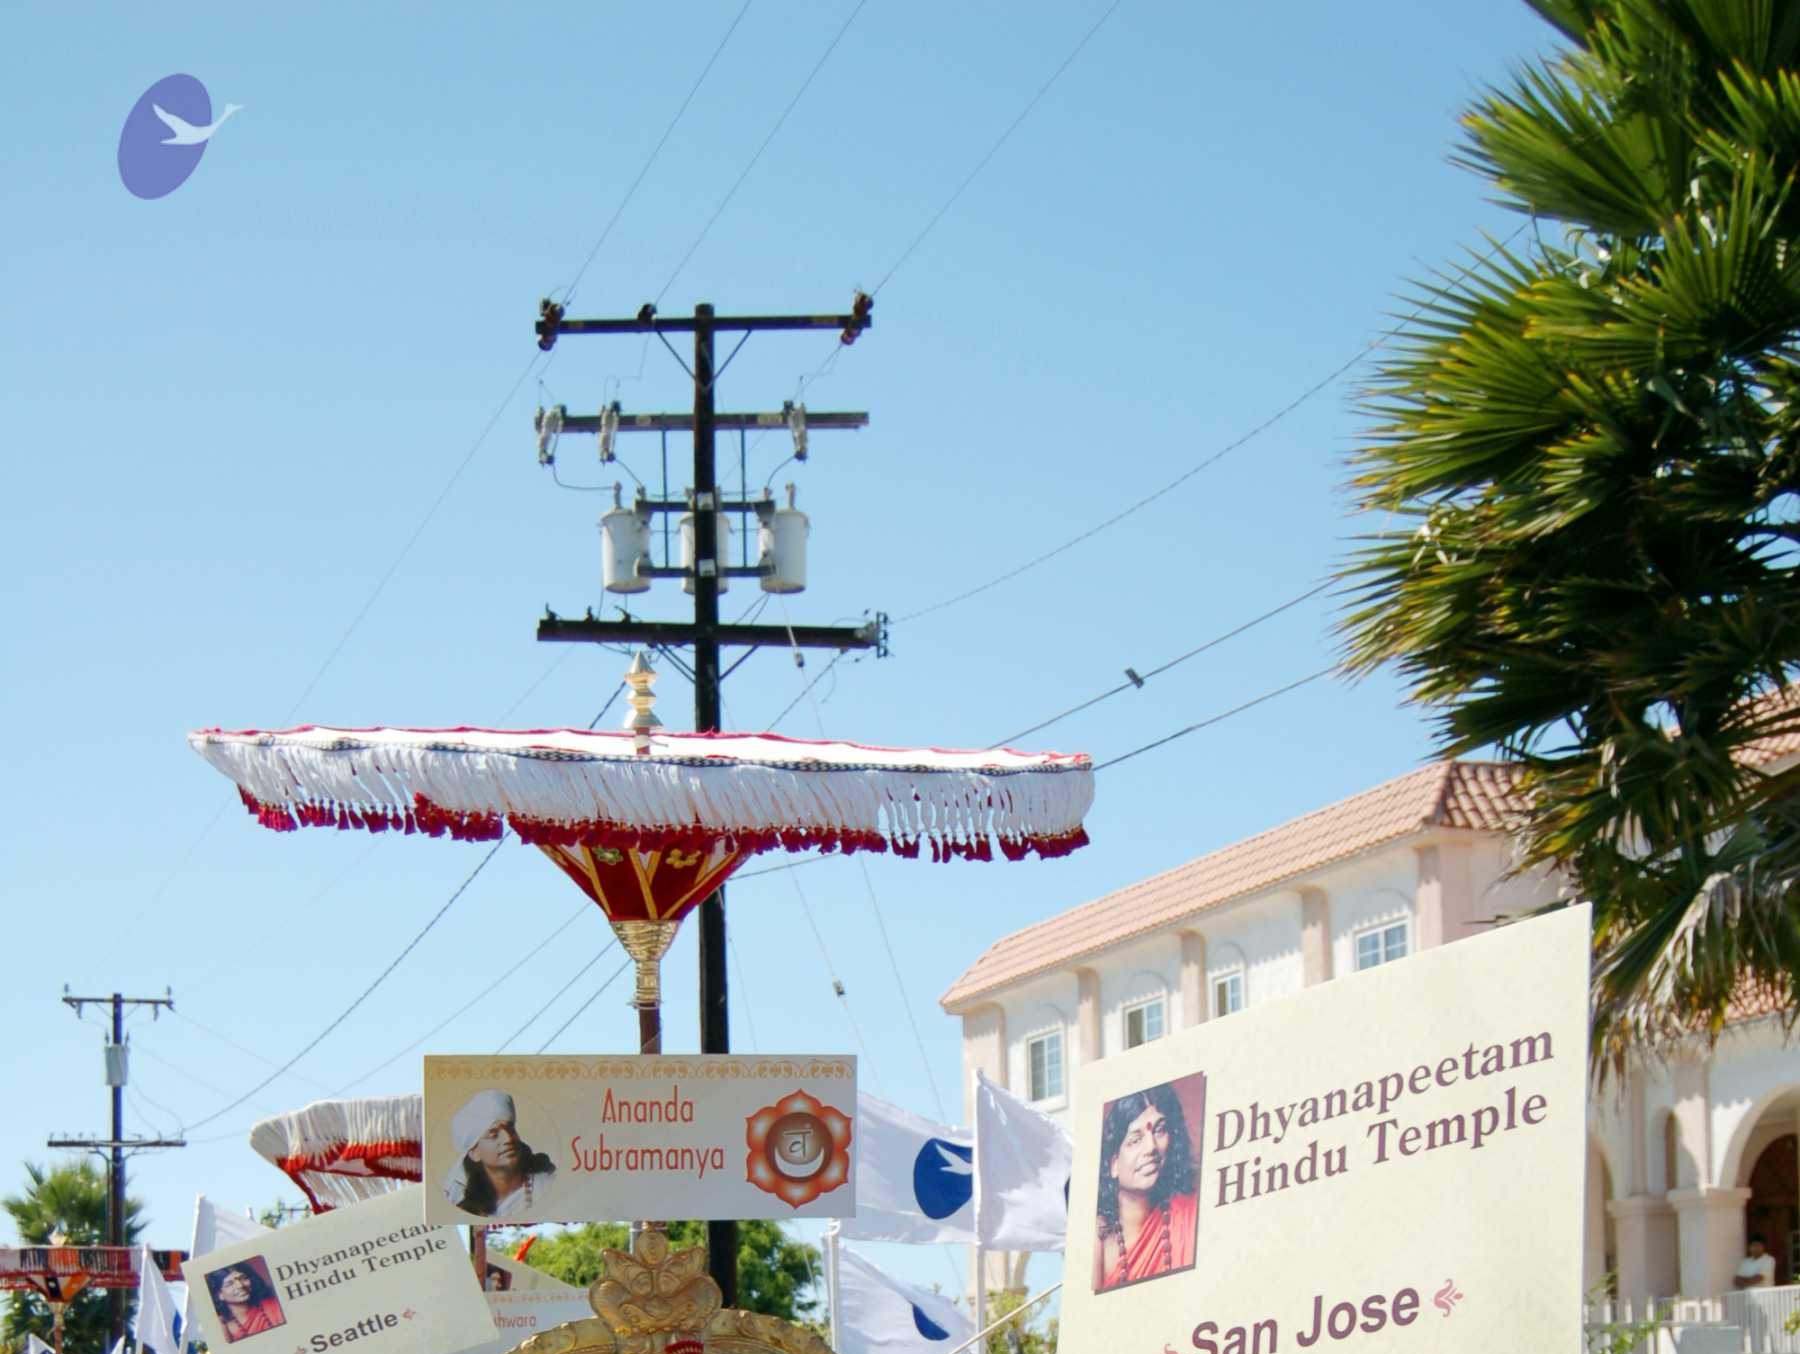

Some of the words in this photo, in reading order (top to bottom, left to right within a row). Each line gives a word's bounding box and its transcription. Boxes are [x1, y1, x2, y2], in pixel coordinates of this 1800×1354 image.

[602, 1085, 694, 1123] Ananda
[1214, 1031, 1554, 1152] Dhyanapeetam
[571, 1133, 725, 1179] Subramanya
[1214, 1140, 1348, 1207] Hindu
[1367, 1086, 1548, 1164] Temple
[284, 1268, 357, 1300] Hindu
[361, 1238, 448, 1273] Temple
[310, 1313, 398, 1353] Seattle
[493, 1309, 537, 1328] hwara
[1296, 1287, 1420, 1347] Jose
